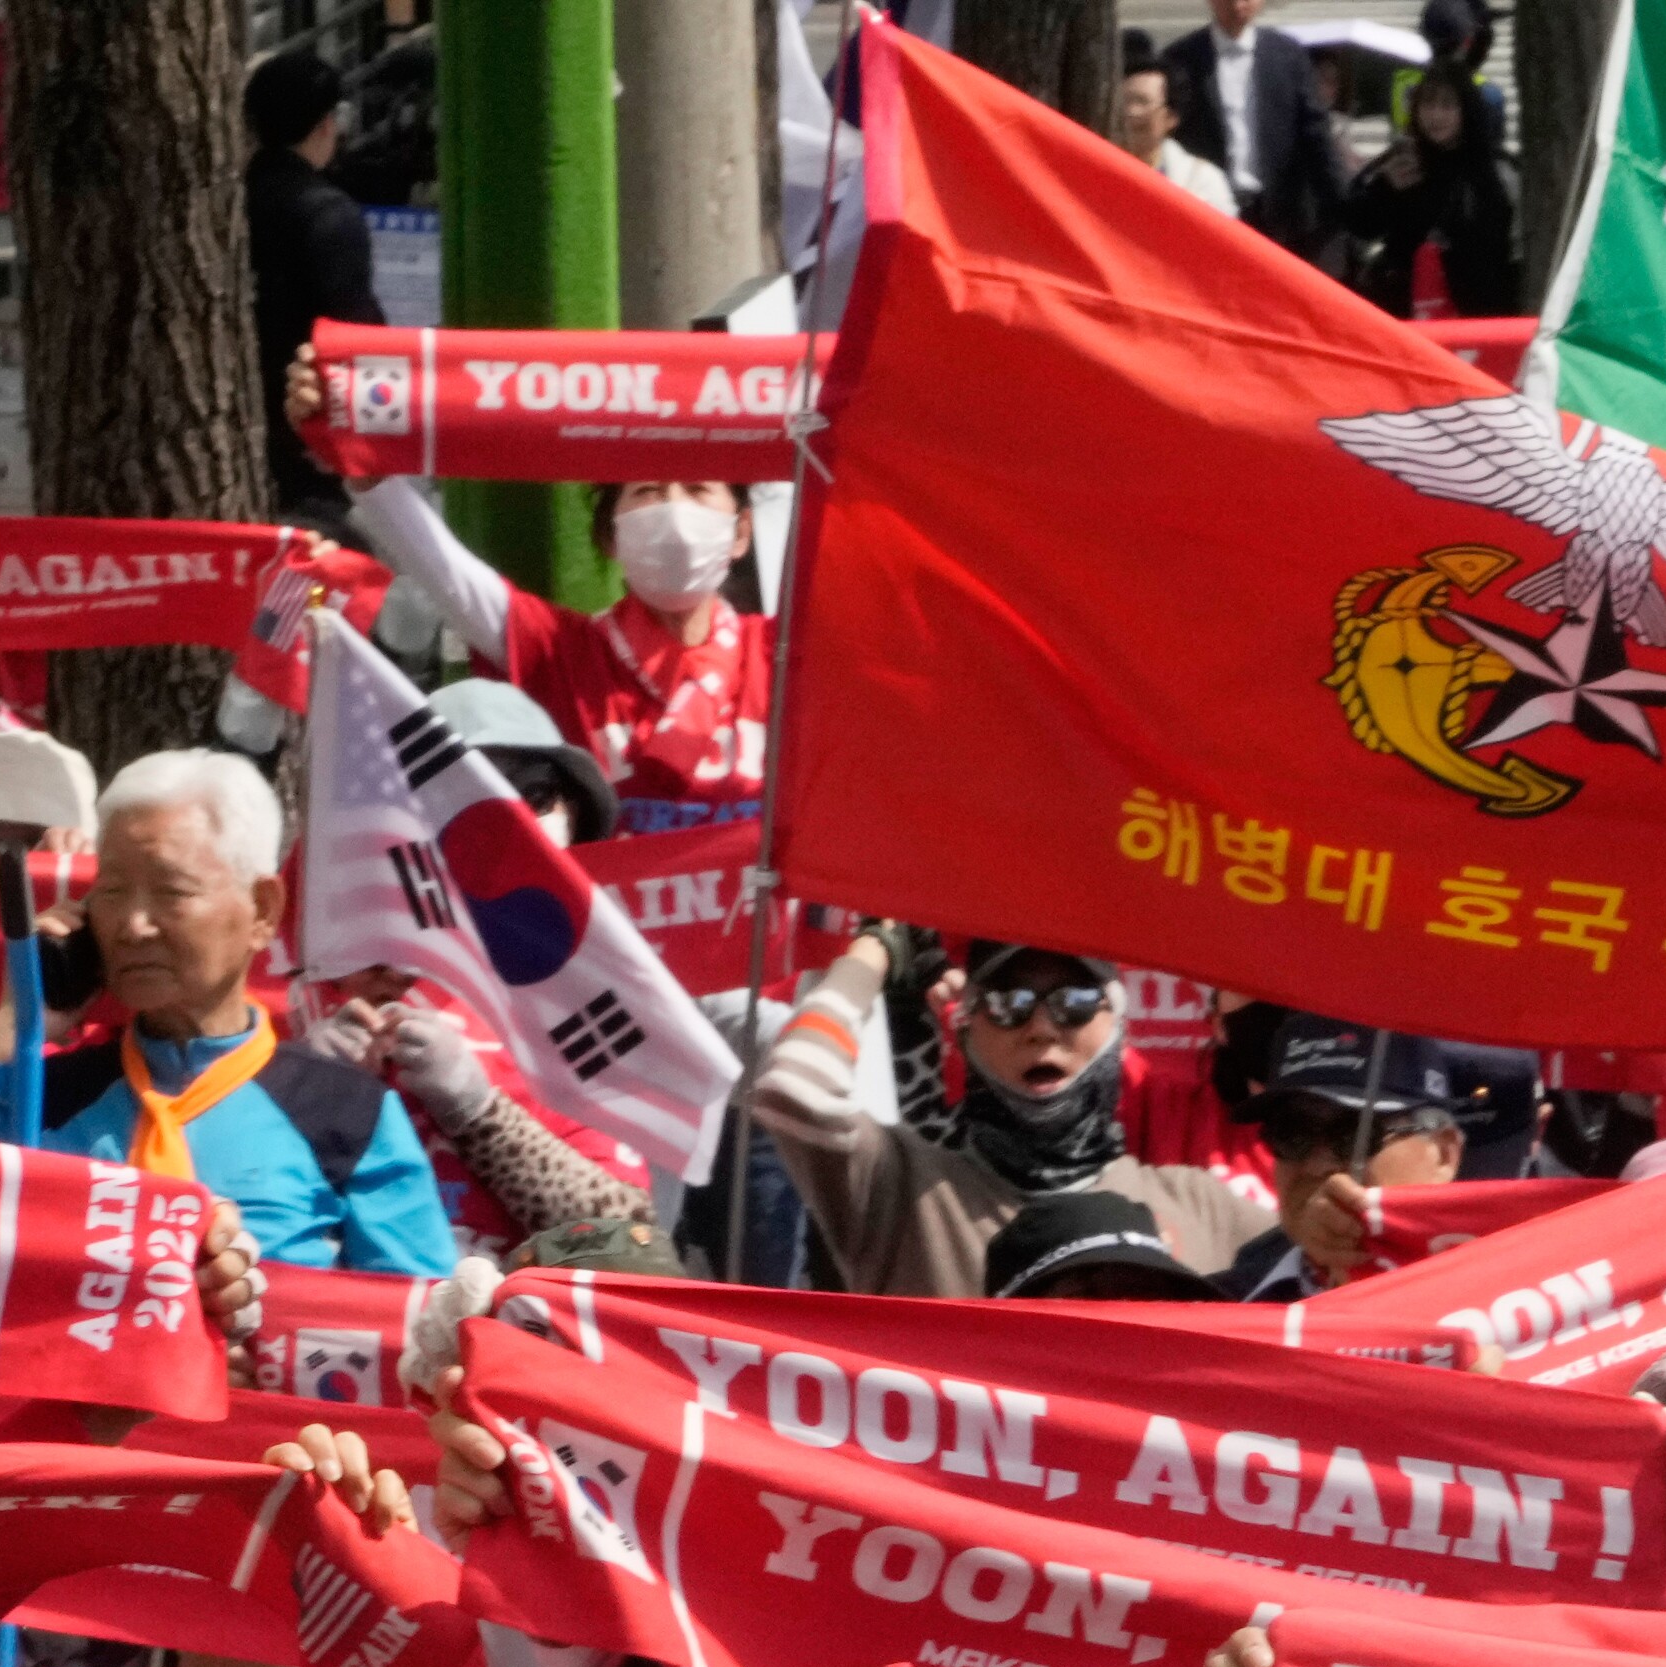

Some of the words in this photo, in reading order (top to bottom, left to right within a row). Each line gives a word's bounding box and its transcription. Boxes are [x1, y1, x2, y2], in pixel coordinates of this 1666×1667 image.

[464, 360, 678, 419] YOON,
[1116, 786, 1395, 933] 해병대
[1425, 865, 1630, 973] 호국
[66, 1160, 140, 1353] AGAIN
[133, 1193, 204, 1333] 2025
[657, 1326, 1082, 1502] YOON,
[1116, 1414, 1564, 1574] AGAIN
[757, 1490, 1168, 1665] YOON,
